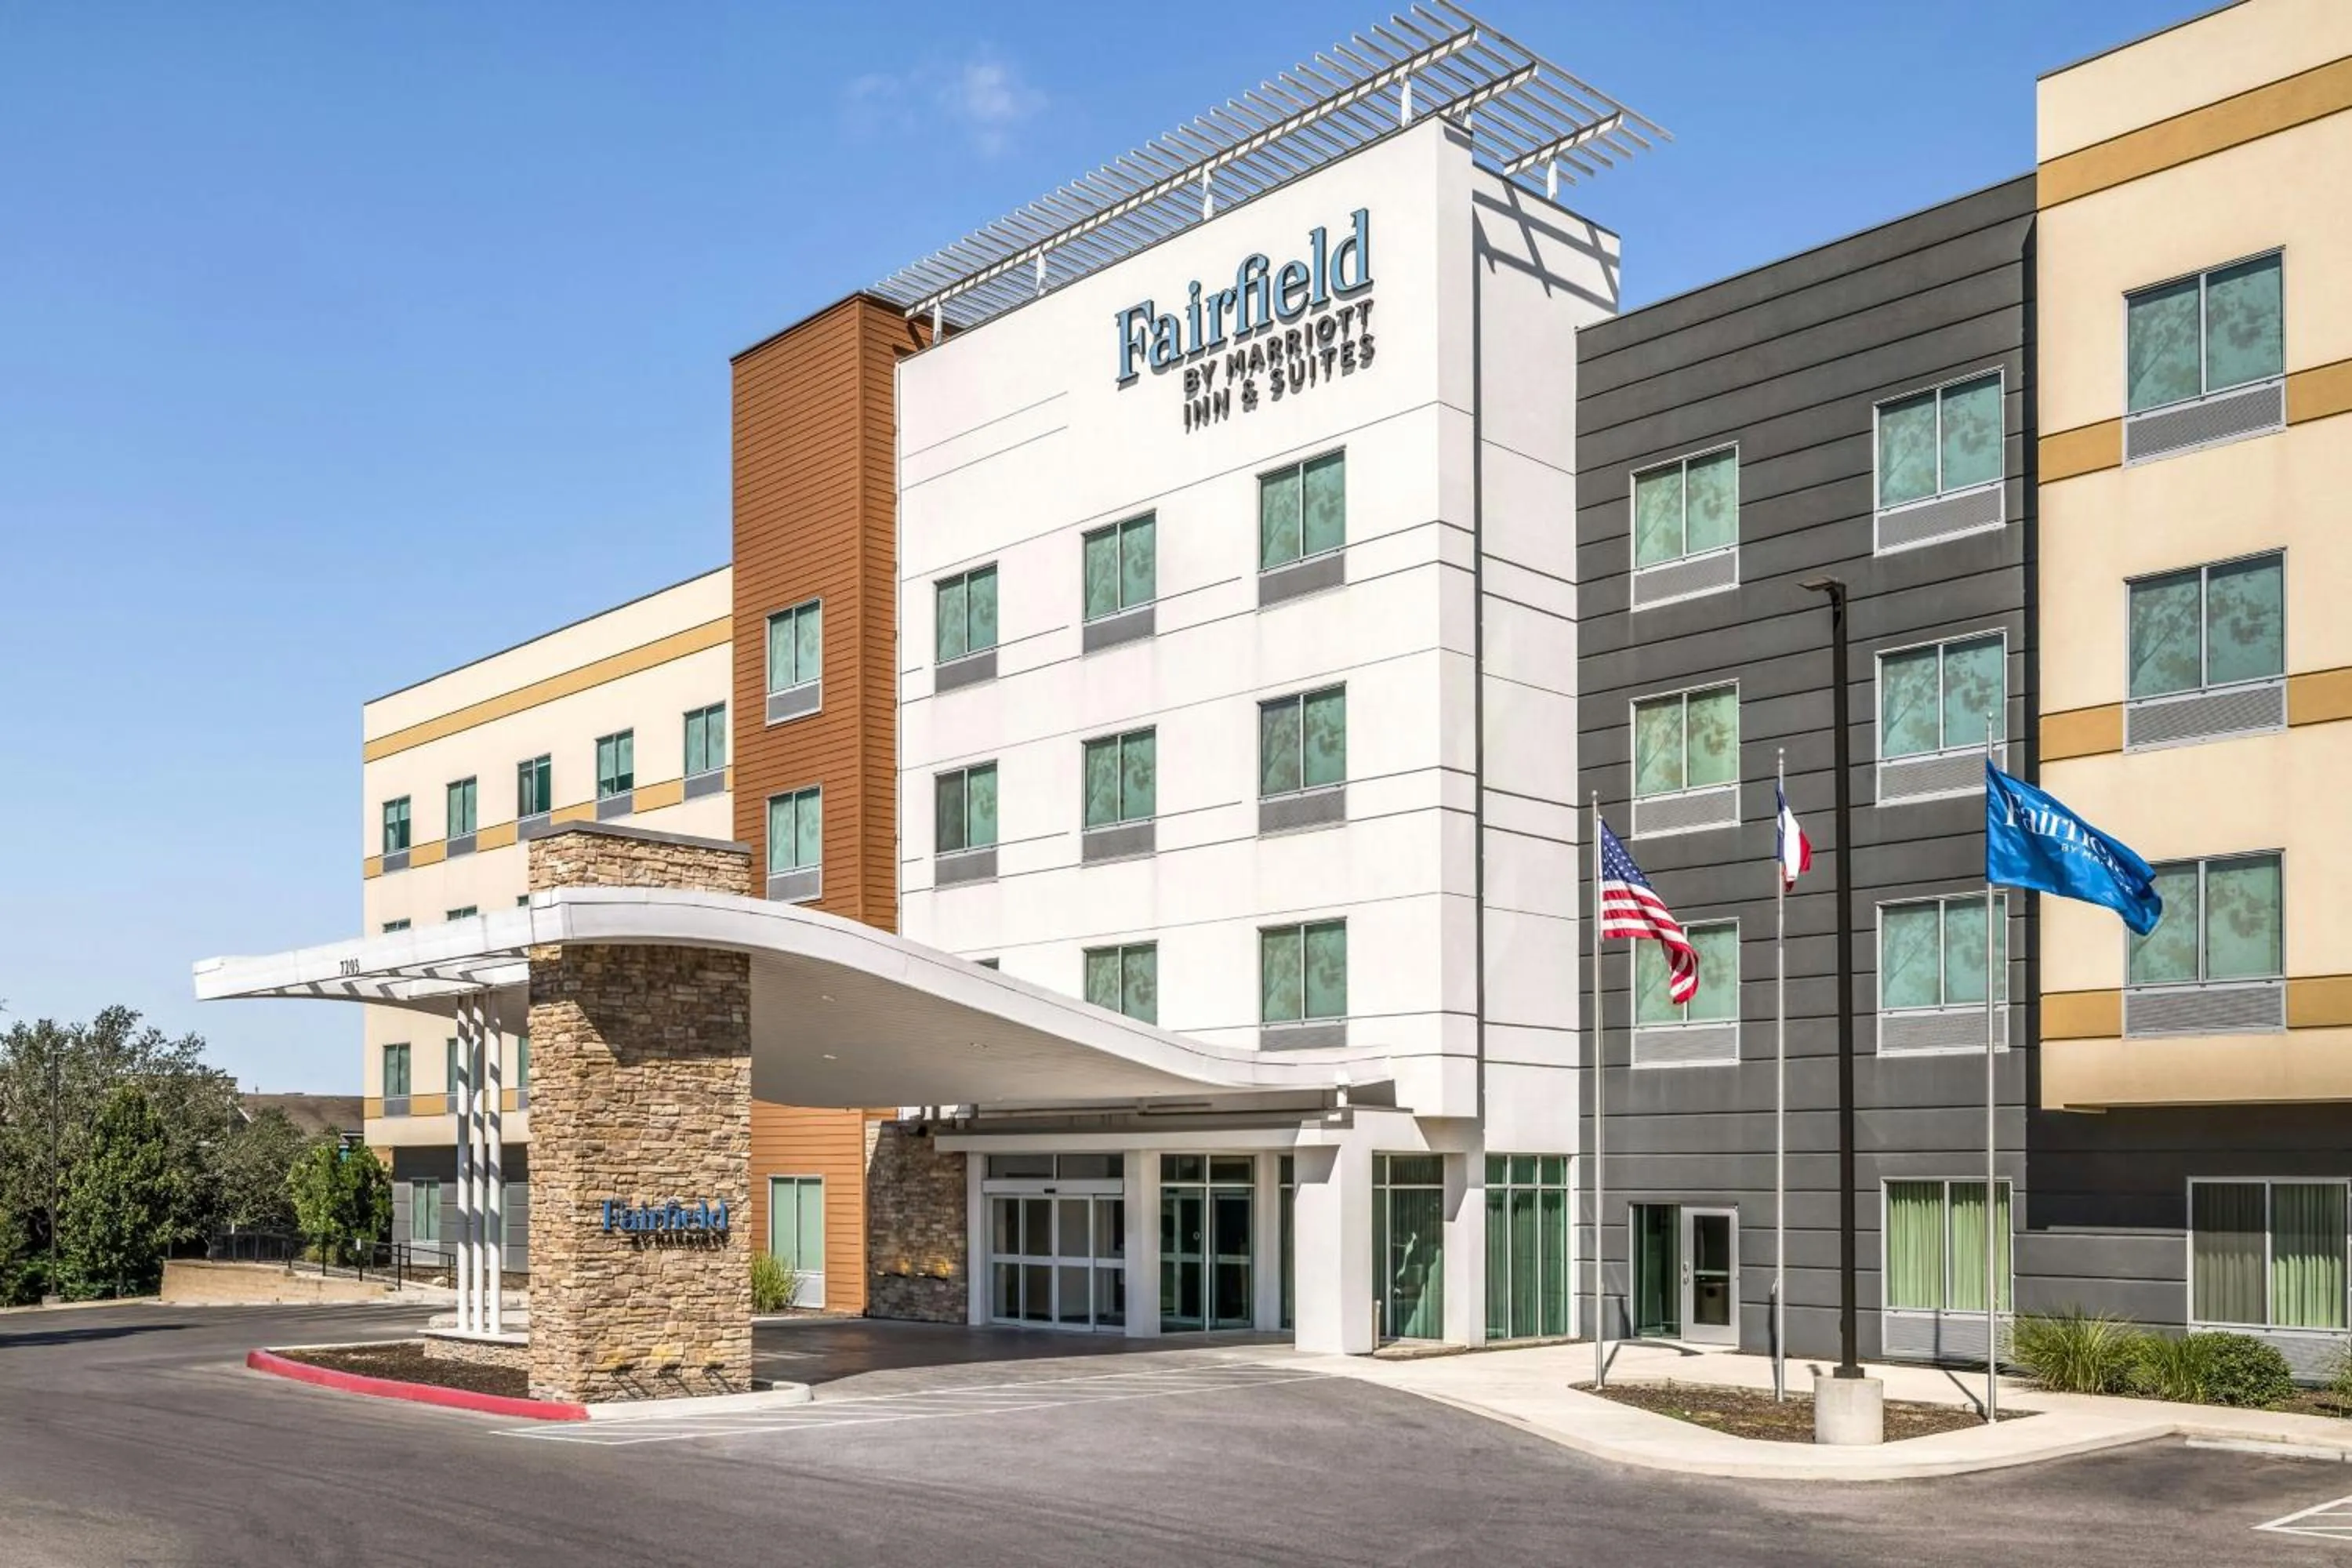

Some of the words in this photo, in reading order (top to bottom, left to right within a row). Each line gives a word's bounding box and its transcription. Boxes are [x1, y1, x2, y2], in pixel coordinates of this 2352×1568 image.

[1115, 207, 1374, 384] Fairfield
[1183, 387, 1230, 429] INN
[1241, 379, 1258, 408] &
[1269, 333, 1375, 396] SUITES
[1184, 360, 1217, 395] BY
[1225, 299, 1374, 381] MARRIOTT
[602, 1198, 728, 1232] Fairfield
